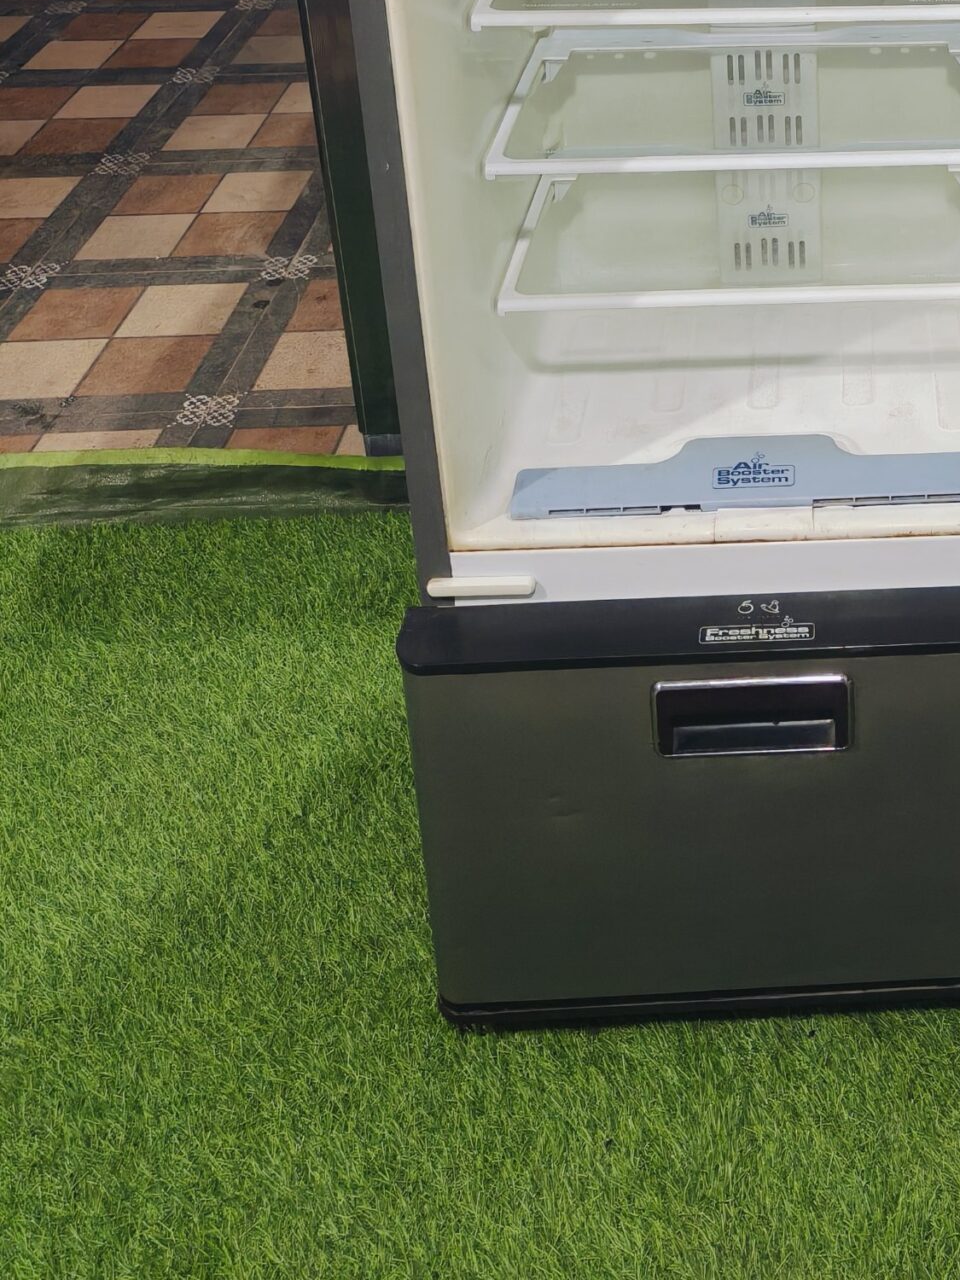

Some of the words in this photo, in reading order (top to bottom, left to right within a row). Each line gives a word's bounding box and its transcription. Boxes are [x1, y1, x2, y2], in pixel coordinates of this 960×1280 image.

[733, 461, 770, 470] Air
[717, 468, 790, 477] Booster
[717, 476, 789, 487] System
[706, 627, 810, 636] Freshness
